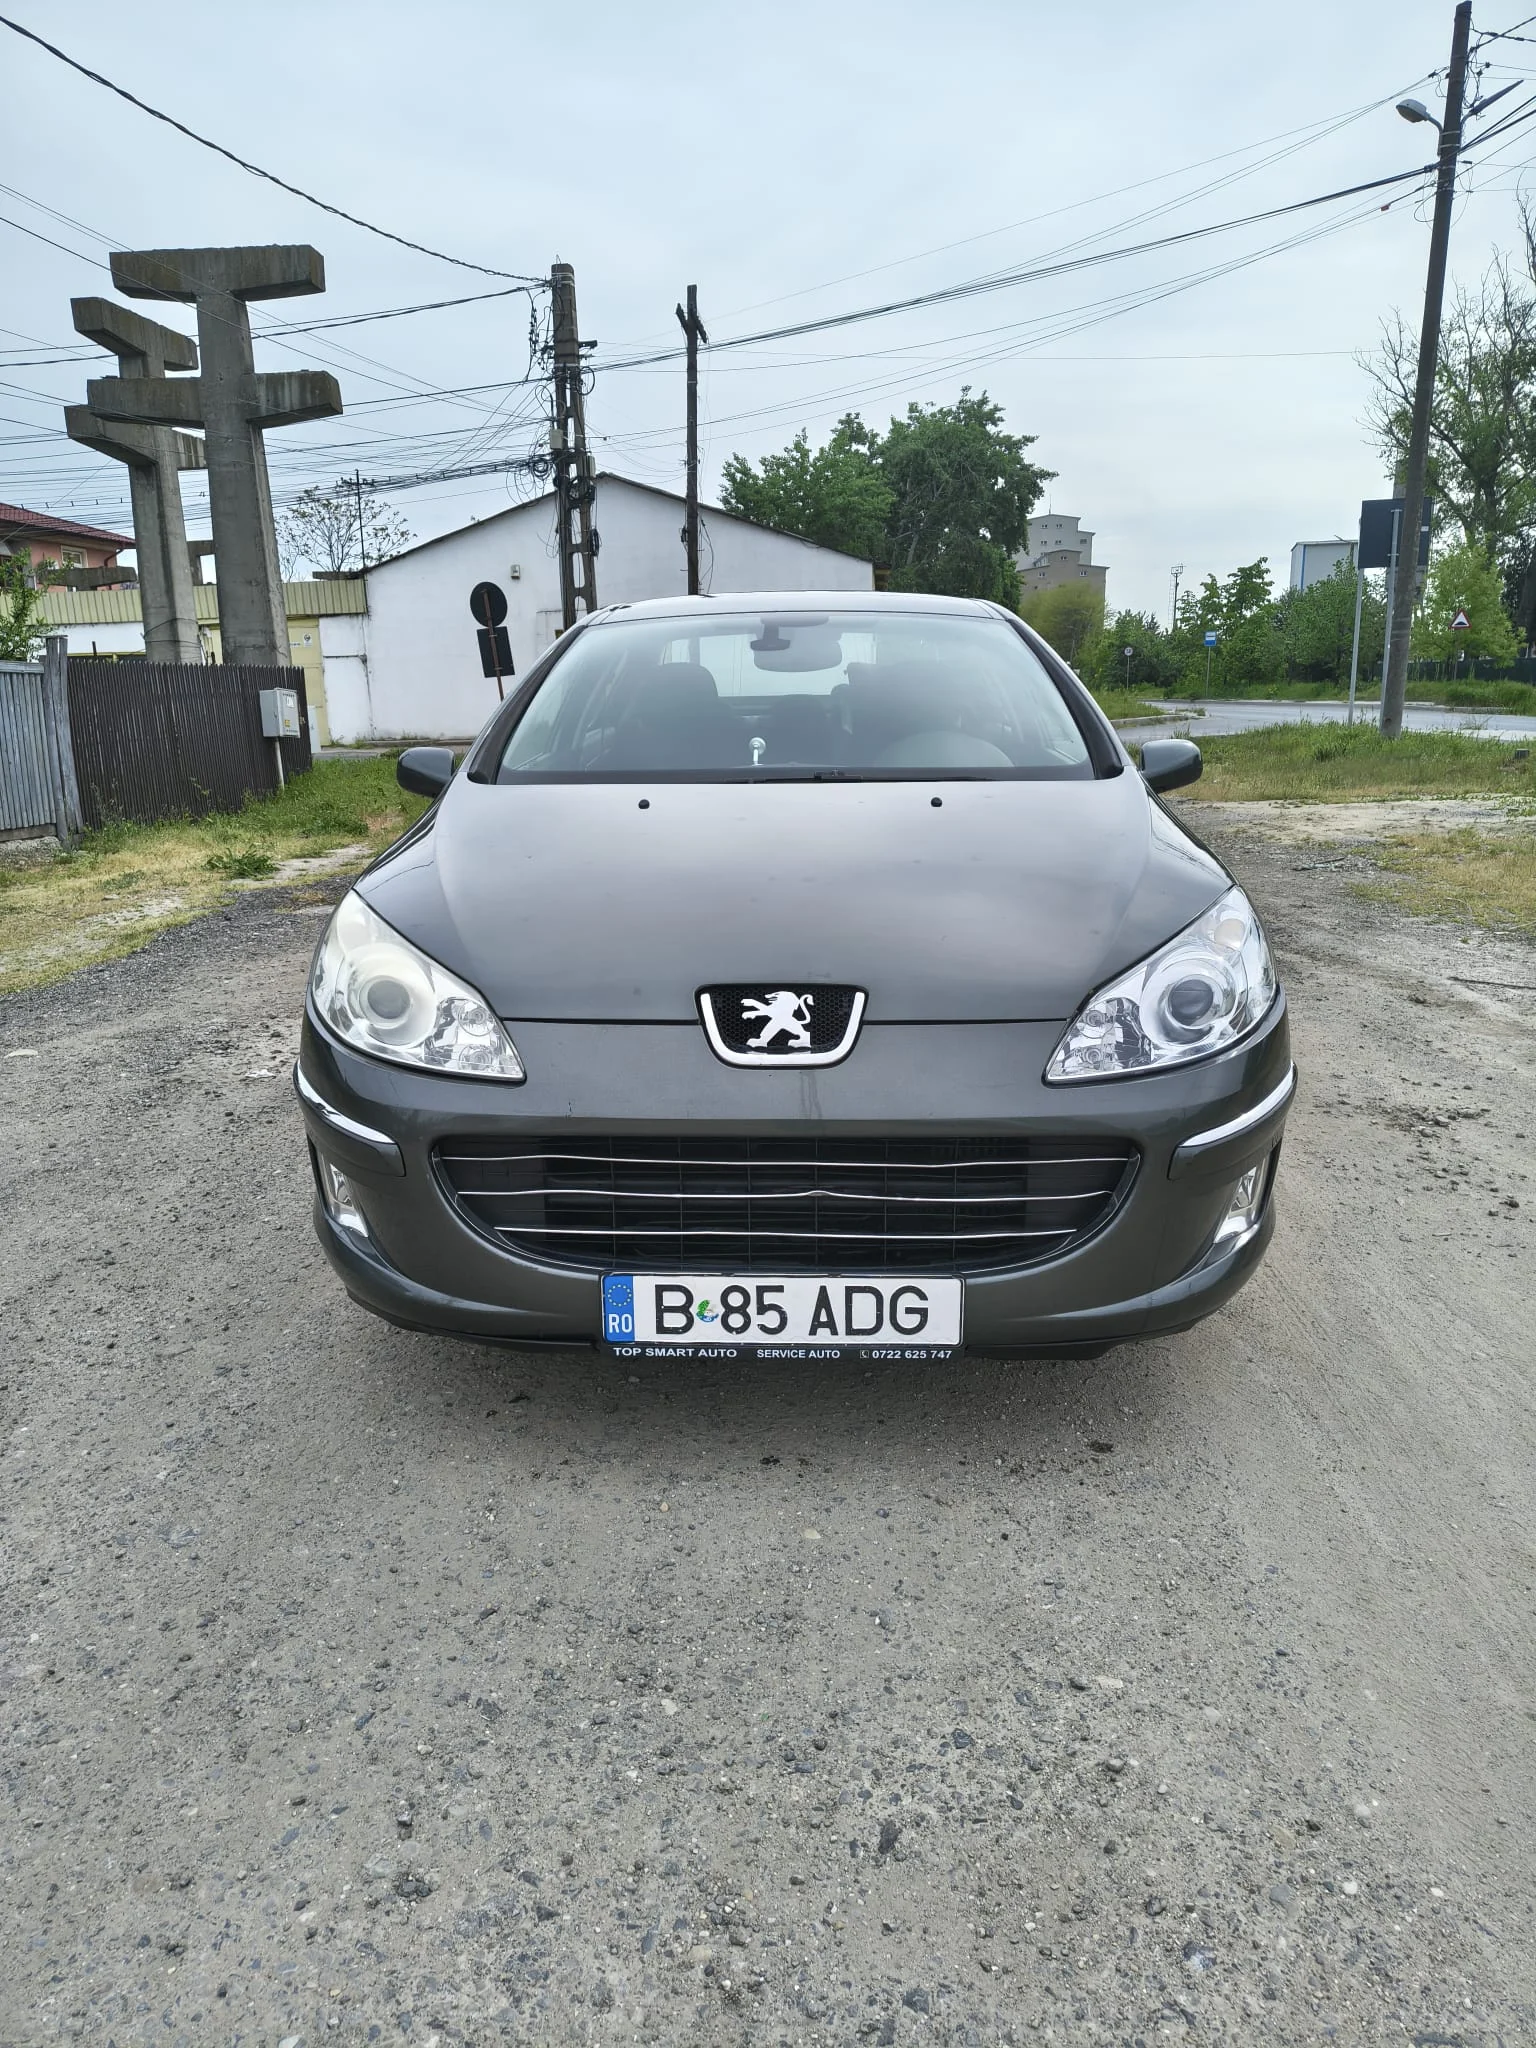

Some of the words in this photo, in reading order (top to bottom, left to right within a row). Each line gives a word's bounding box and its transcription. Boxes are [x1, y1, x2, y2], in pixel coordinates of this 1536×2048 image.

[655, 1284, 694, 1335] B
[720, 1284, 788, 1336] 85
[808, 1285, 929, 1336] ADG
[609, 1313, 633, 1334] RO
[613, 1347, 642, 1357] TOP
[645, 1347, 695, 1357] SMART
[698, 1348, 738, 1358] AUTO
[756, 1349, 806, 1359] SERVICE
[808, 1349, 841, 1359] AUTO
[872, 1350, 901, 1359] 0722
[905, 1350, 927, 1359] 625
[931, 1350, 952, 1359] 747
